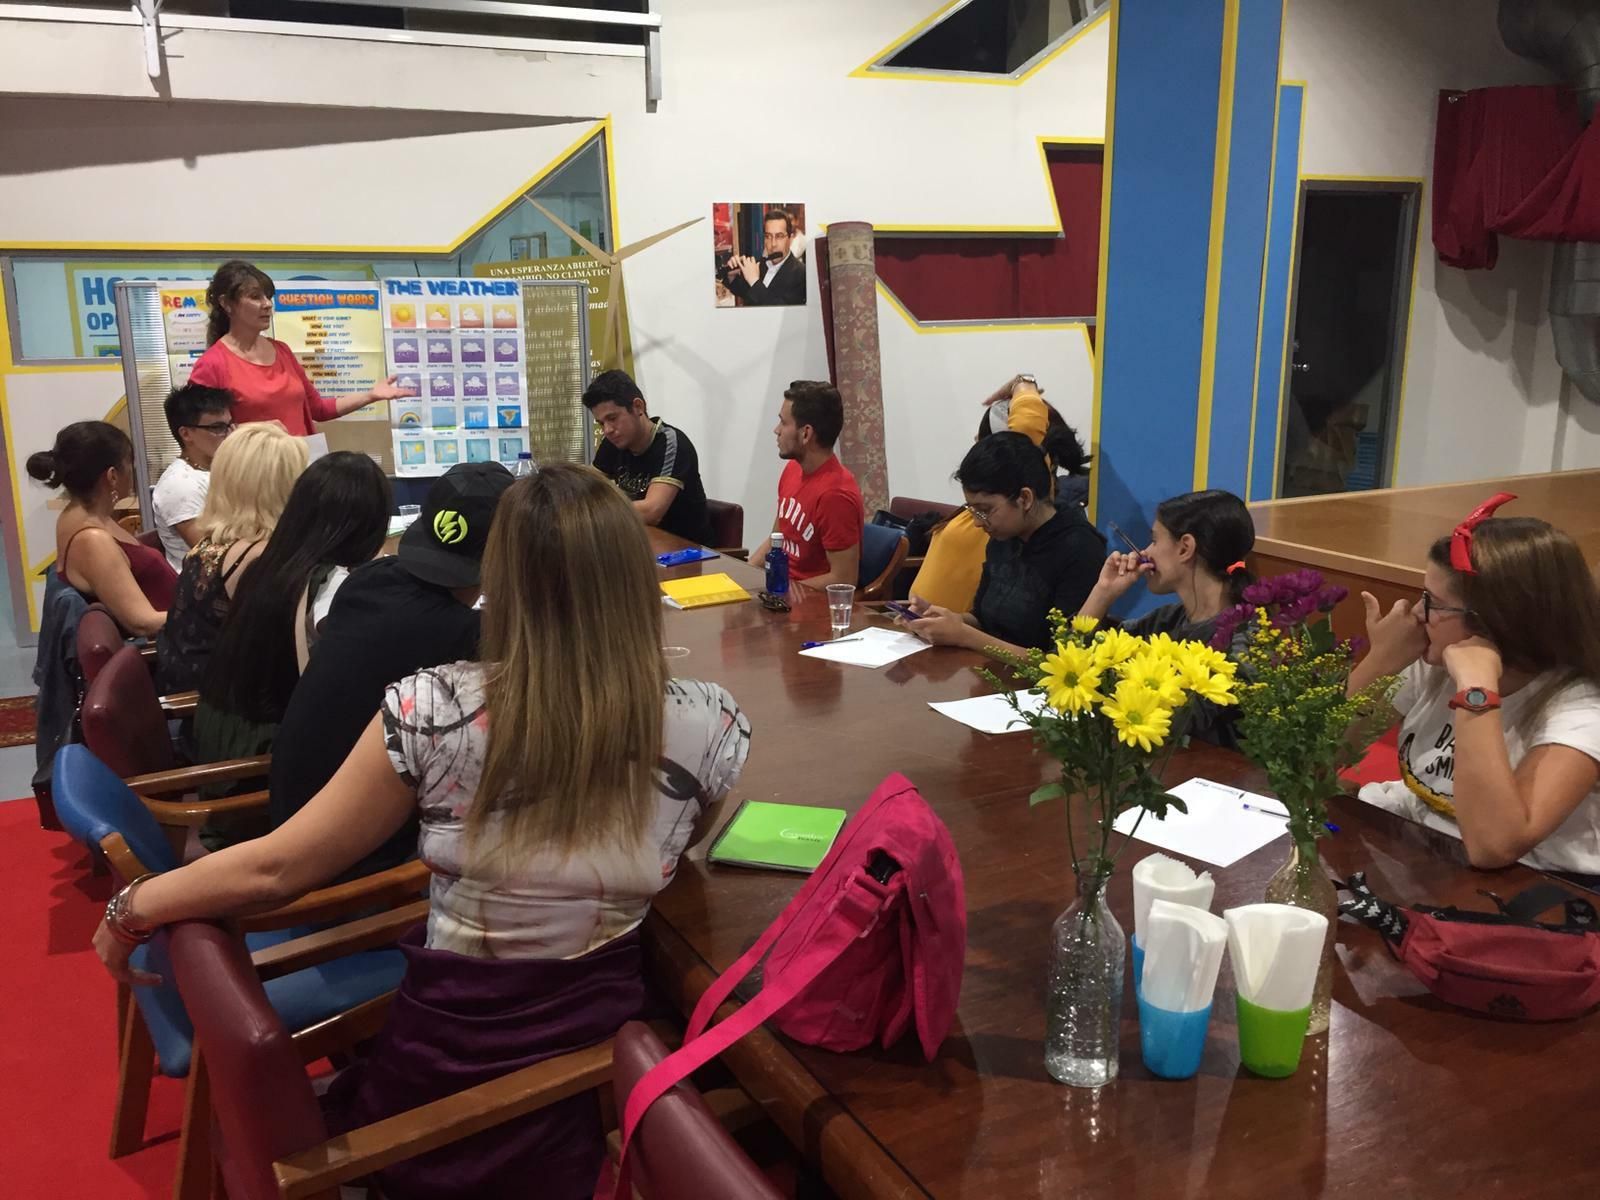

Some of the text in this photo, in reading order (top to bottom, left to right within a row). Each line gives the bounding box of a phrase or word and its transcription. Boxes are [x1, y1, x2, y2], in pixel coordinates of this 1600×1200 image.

[490, 260, 602, 276] UNA ESPERANZA ABIERT
[546, 272, 560, 280] NO
[384, 279, 423, 296] THE
[426, 279, 519, 296] WEATHER
[278, 294, 375, 305] QUESTION WORDS
[86, 312, 117, 330] OP
[1425, 755, 1455, 781] SMI
